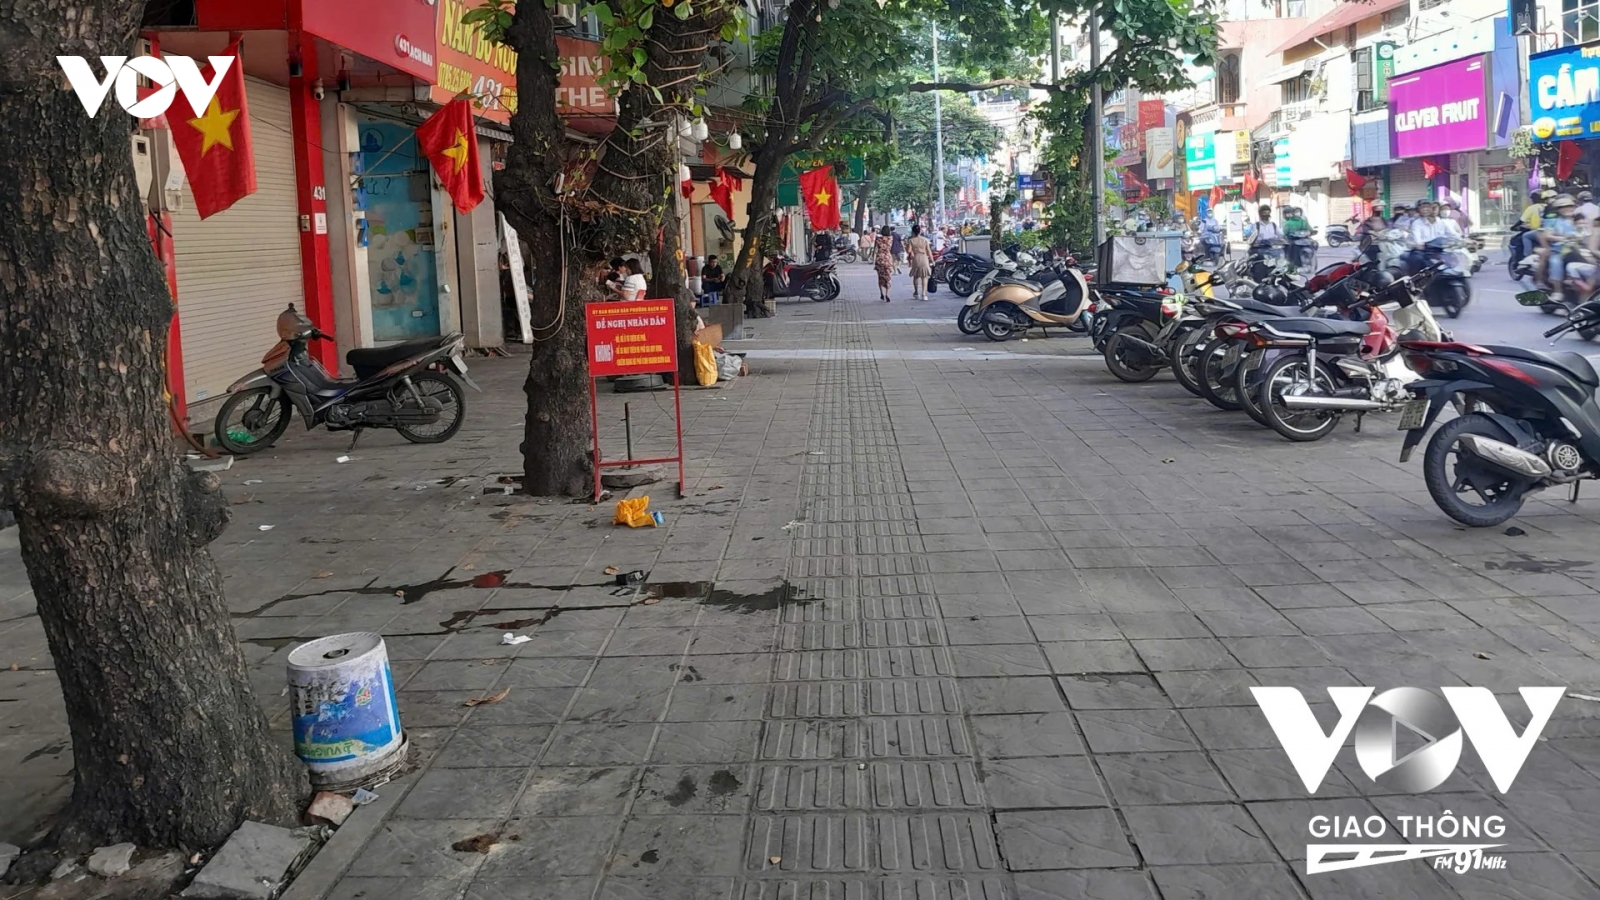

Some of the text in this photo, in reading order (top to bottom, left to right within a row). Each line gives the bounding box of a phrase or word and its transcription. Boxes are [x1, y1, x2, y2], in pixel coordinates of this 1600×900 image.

[473, 75, 502, 110] 431
[1395, 97, 1480, 132] KLEVER FRUIT
[313, 186, 326, 200] 431
[607, 319, 626, 330] NGHỊ
[628, 316, 648, 327] NHÂN
[650, 316, 666, 326] DÂN
